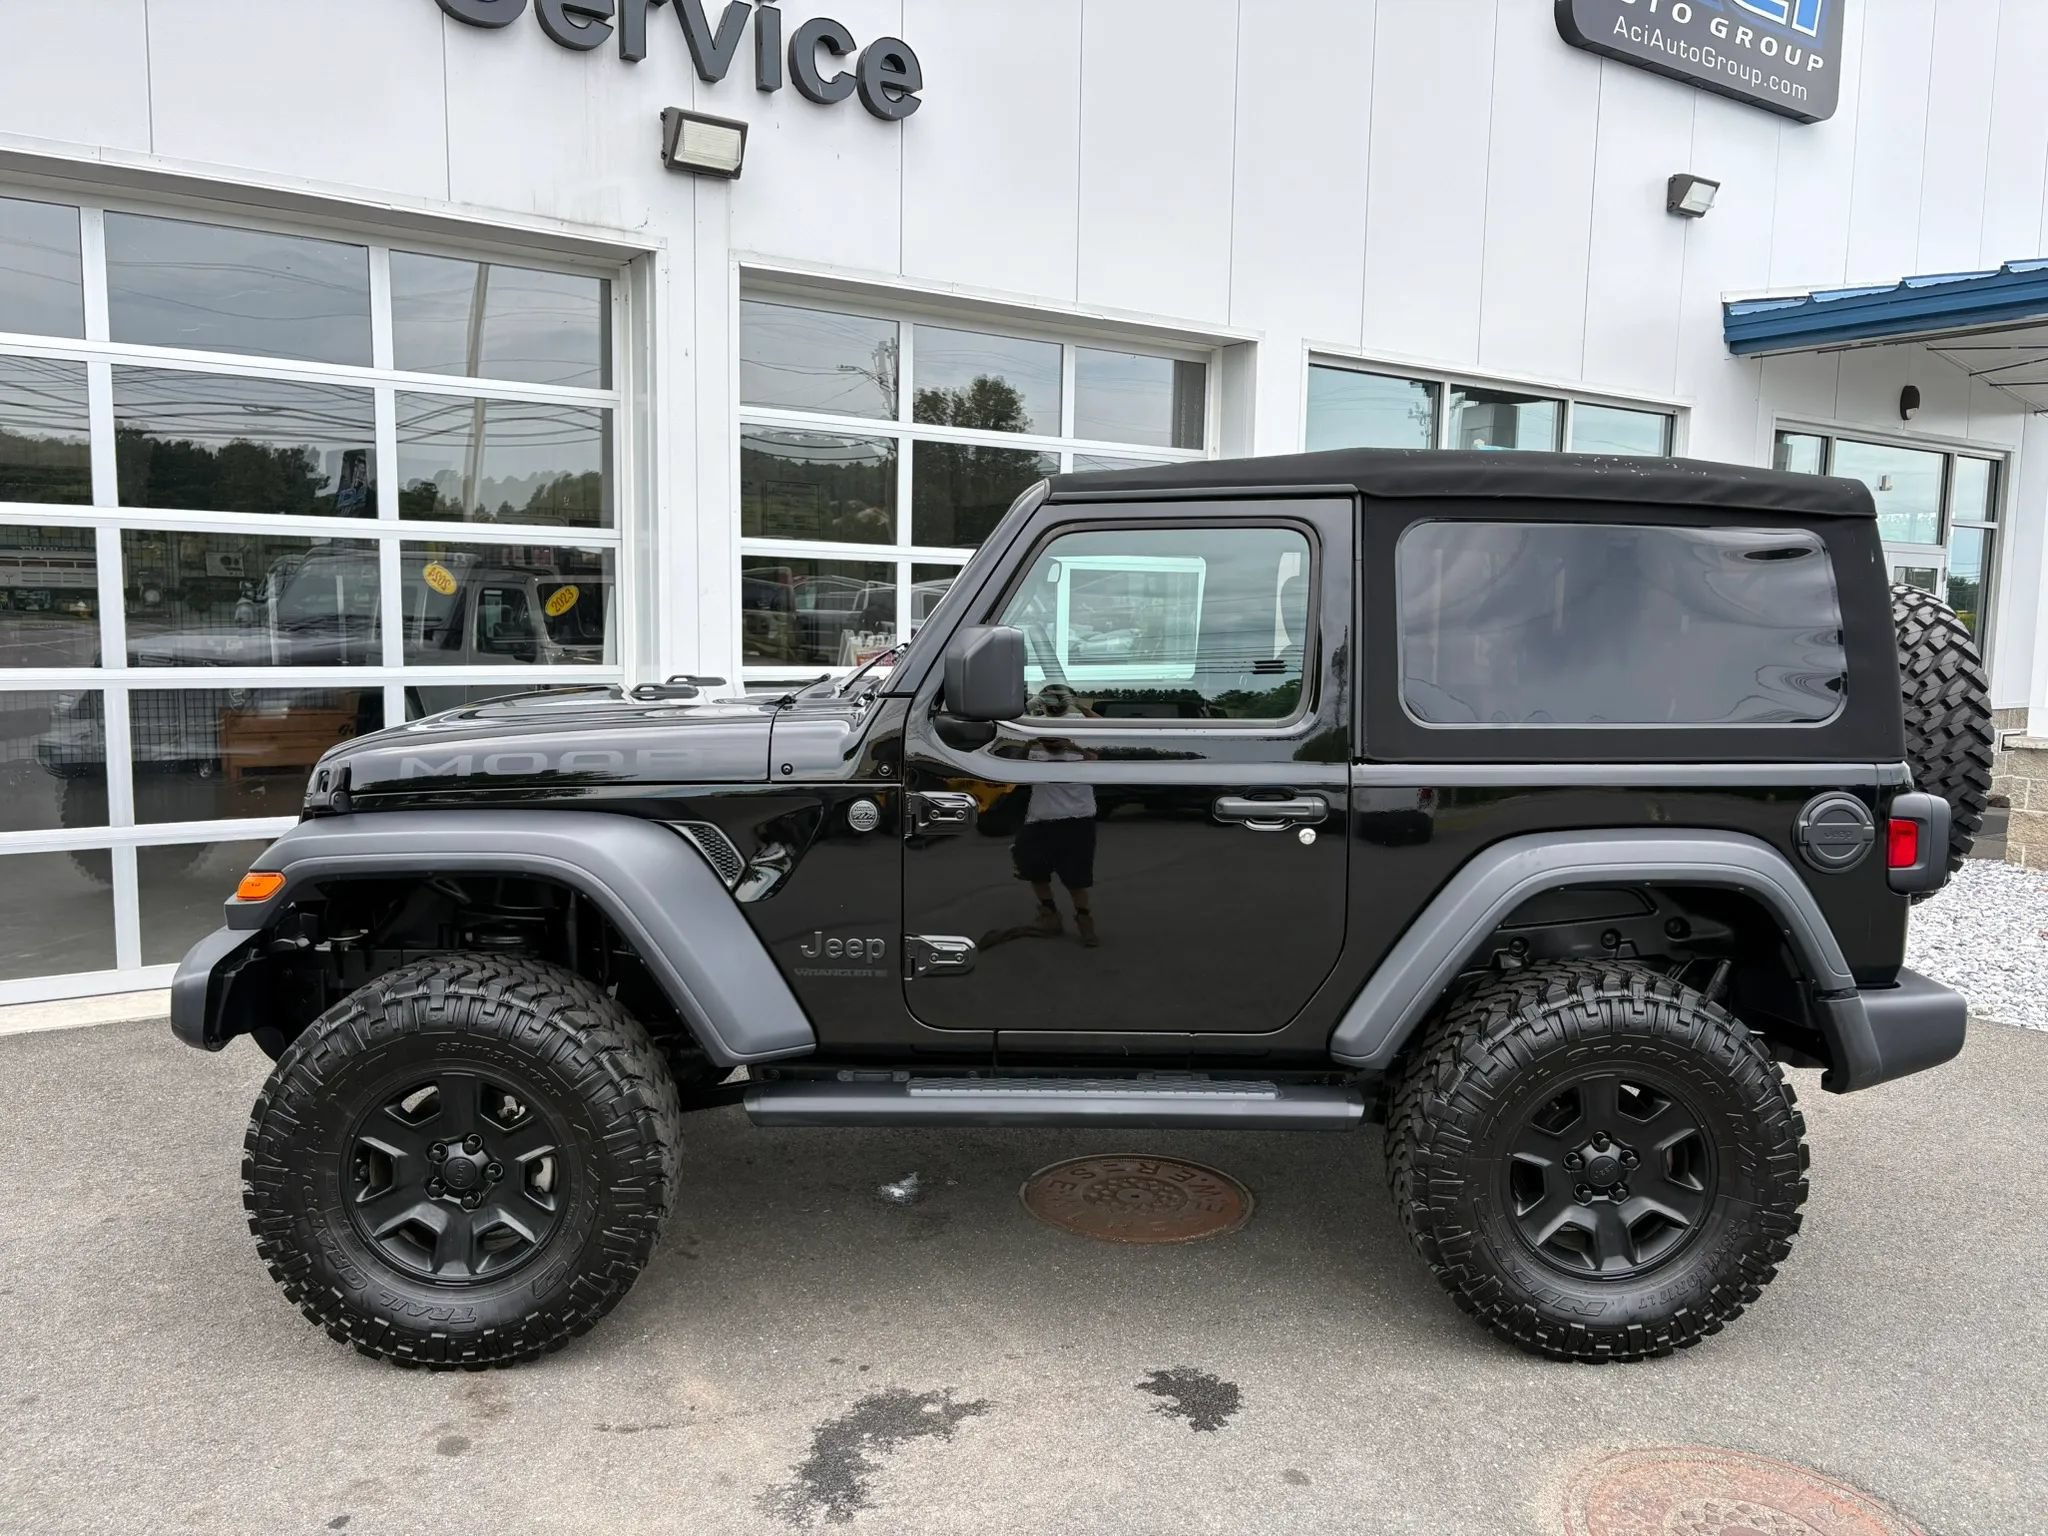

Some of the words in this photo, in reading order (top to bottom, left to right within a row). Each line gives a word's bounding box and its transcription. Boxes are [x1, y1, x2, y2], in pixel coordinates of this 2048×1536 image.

[434, 0, 924, 121] ervice
[1613, 15, 1808, 101] AciAutoGroup.com
[1709, 17, 1824, 72] GROUP
[551, 587, 574, 612] 2023
[800, 931, 886, 964] Jeep
[379, 1289, 477, 1325] TRAIL
